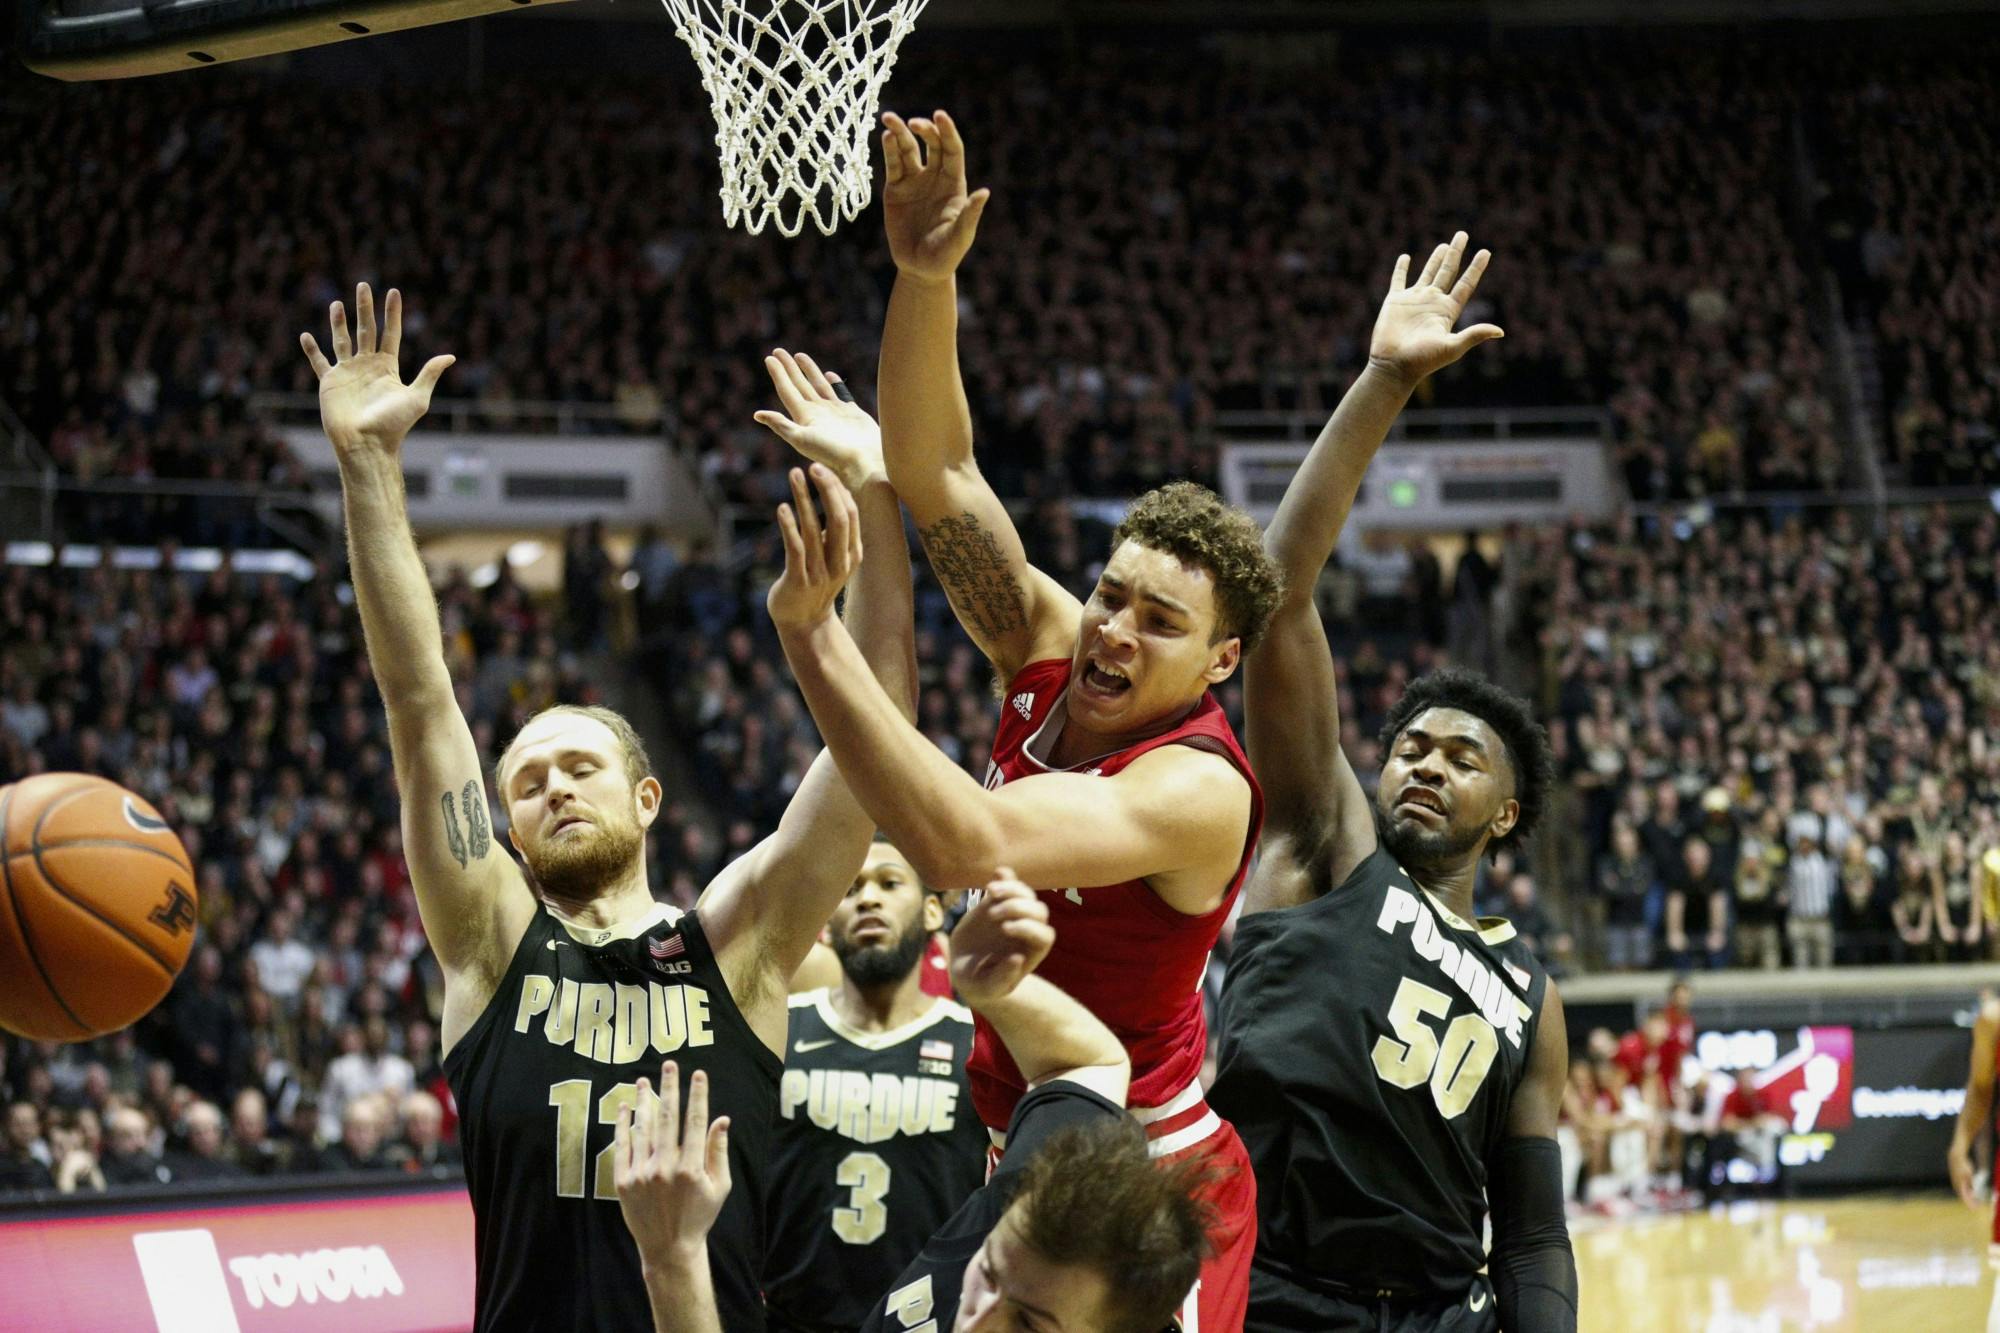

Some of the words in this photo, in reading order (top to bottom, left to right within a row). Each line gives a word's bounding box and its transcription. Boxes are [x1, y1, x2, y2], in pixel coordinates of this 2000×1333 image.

[514, 974, 714, 1064] PURDUE
[1371, 976, 1499, 1120] 50
[780, 1069, 960, 1144] PURDUE
[832, 1152, 891, 1245] 3
[228, 1244, 404, 1309] TOYOTA
